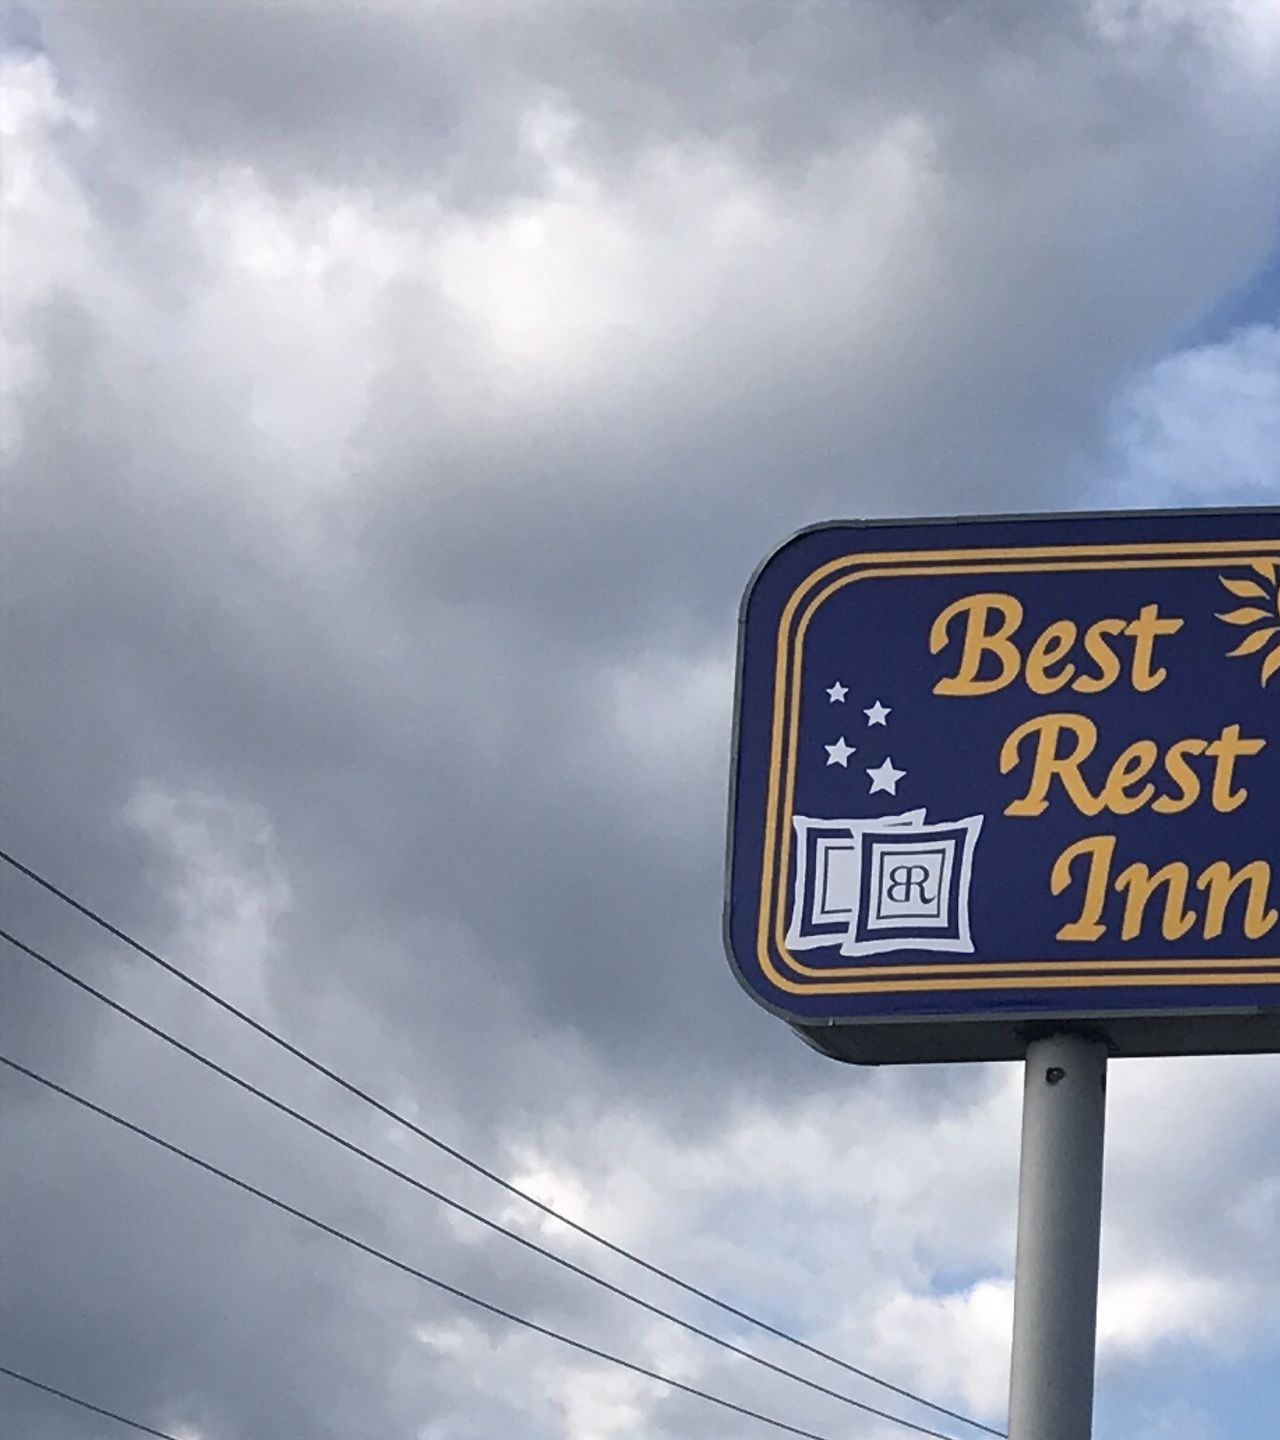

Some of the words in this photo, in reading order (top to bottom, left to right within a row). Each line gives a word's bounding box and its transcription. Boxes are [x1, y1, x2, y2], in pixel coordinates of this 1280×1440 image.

[929, 593, 1184, 696] Best
[1000, 713, 1267, 816] Rest
[1050, 835, 1279, 942] Inn
